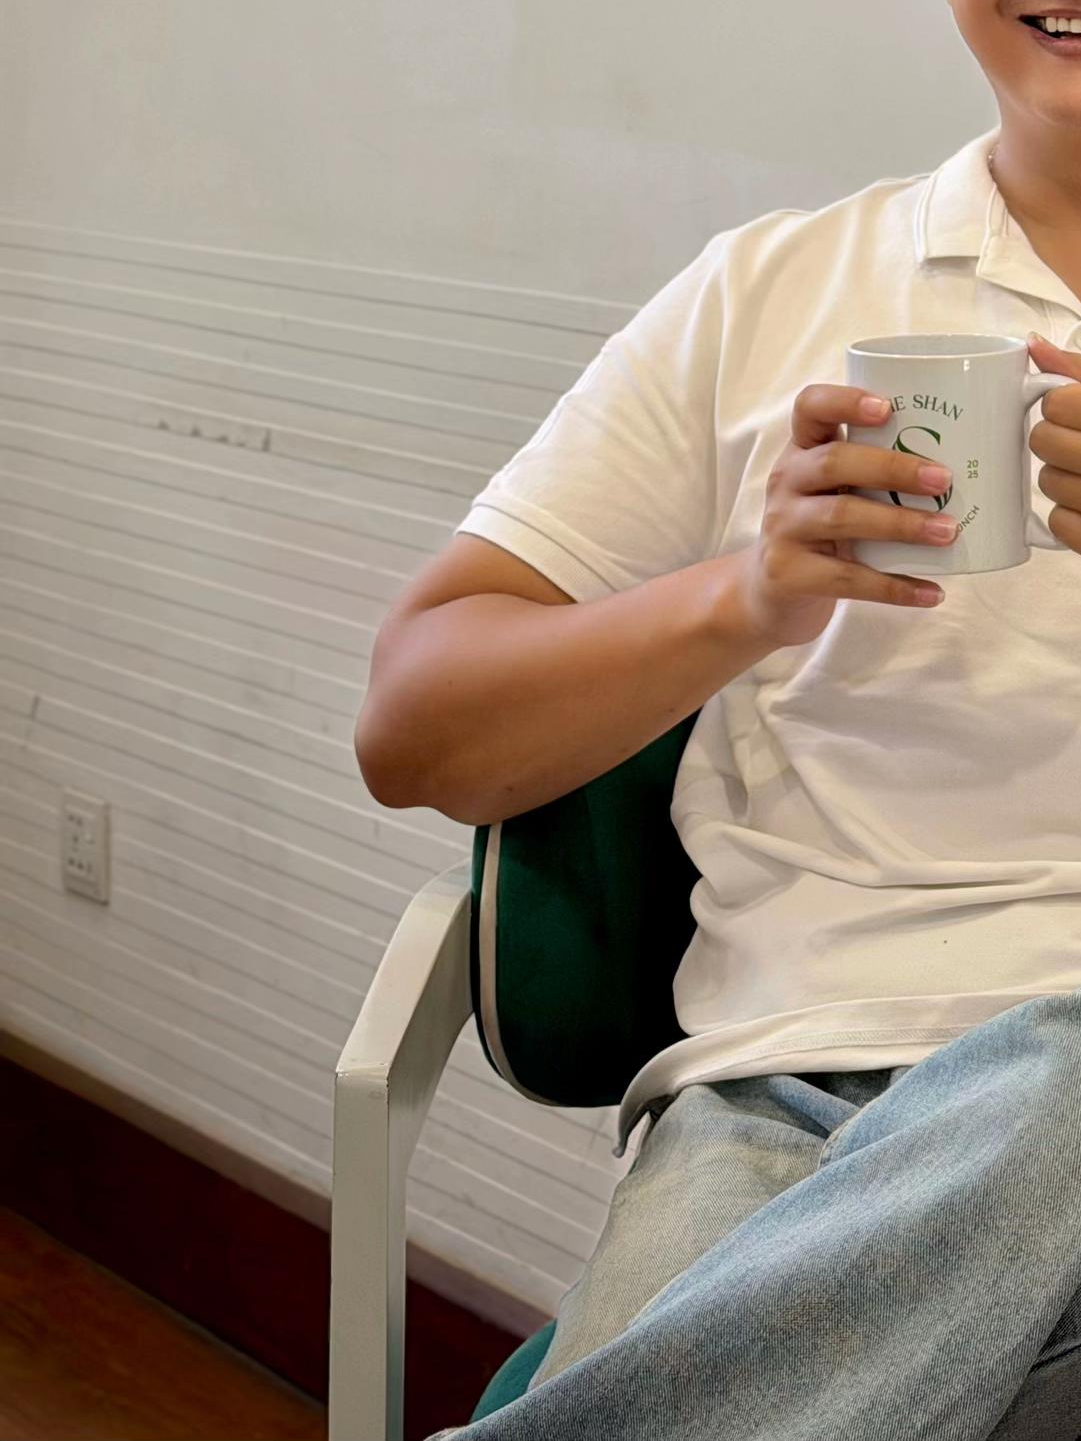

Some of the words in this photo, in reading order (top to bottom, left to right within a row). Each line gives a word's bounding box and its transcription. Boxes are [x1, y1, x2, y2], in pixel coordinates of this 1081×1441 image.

[912, 393, 964, 421] SHAN
[967, 460, 979, 469] 20
[967, 470, 979, 479] 25
